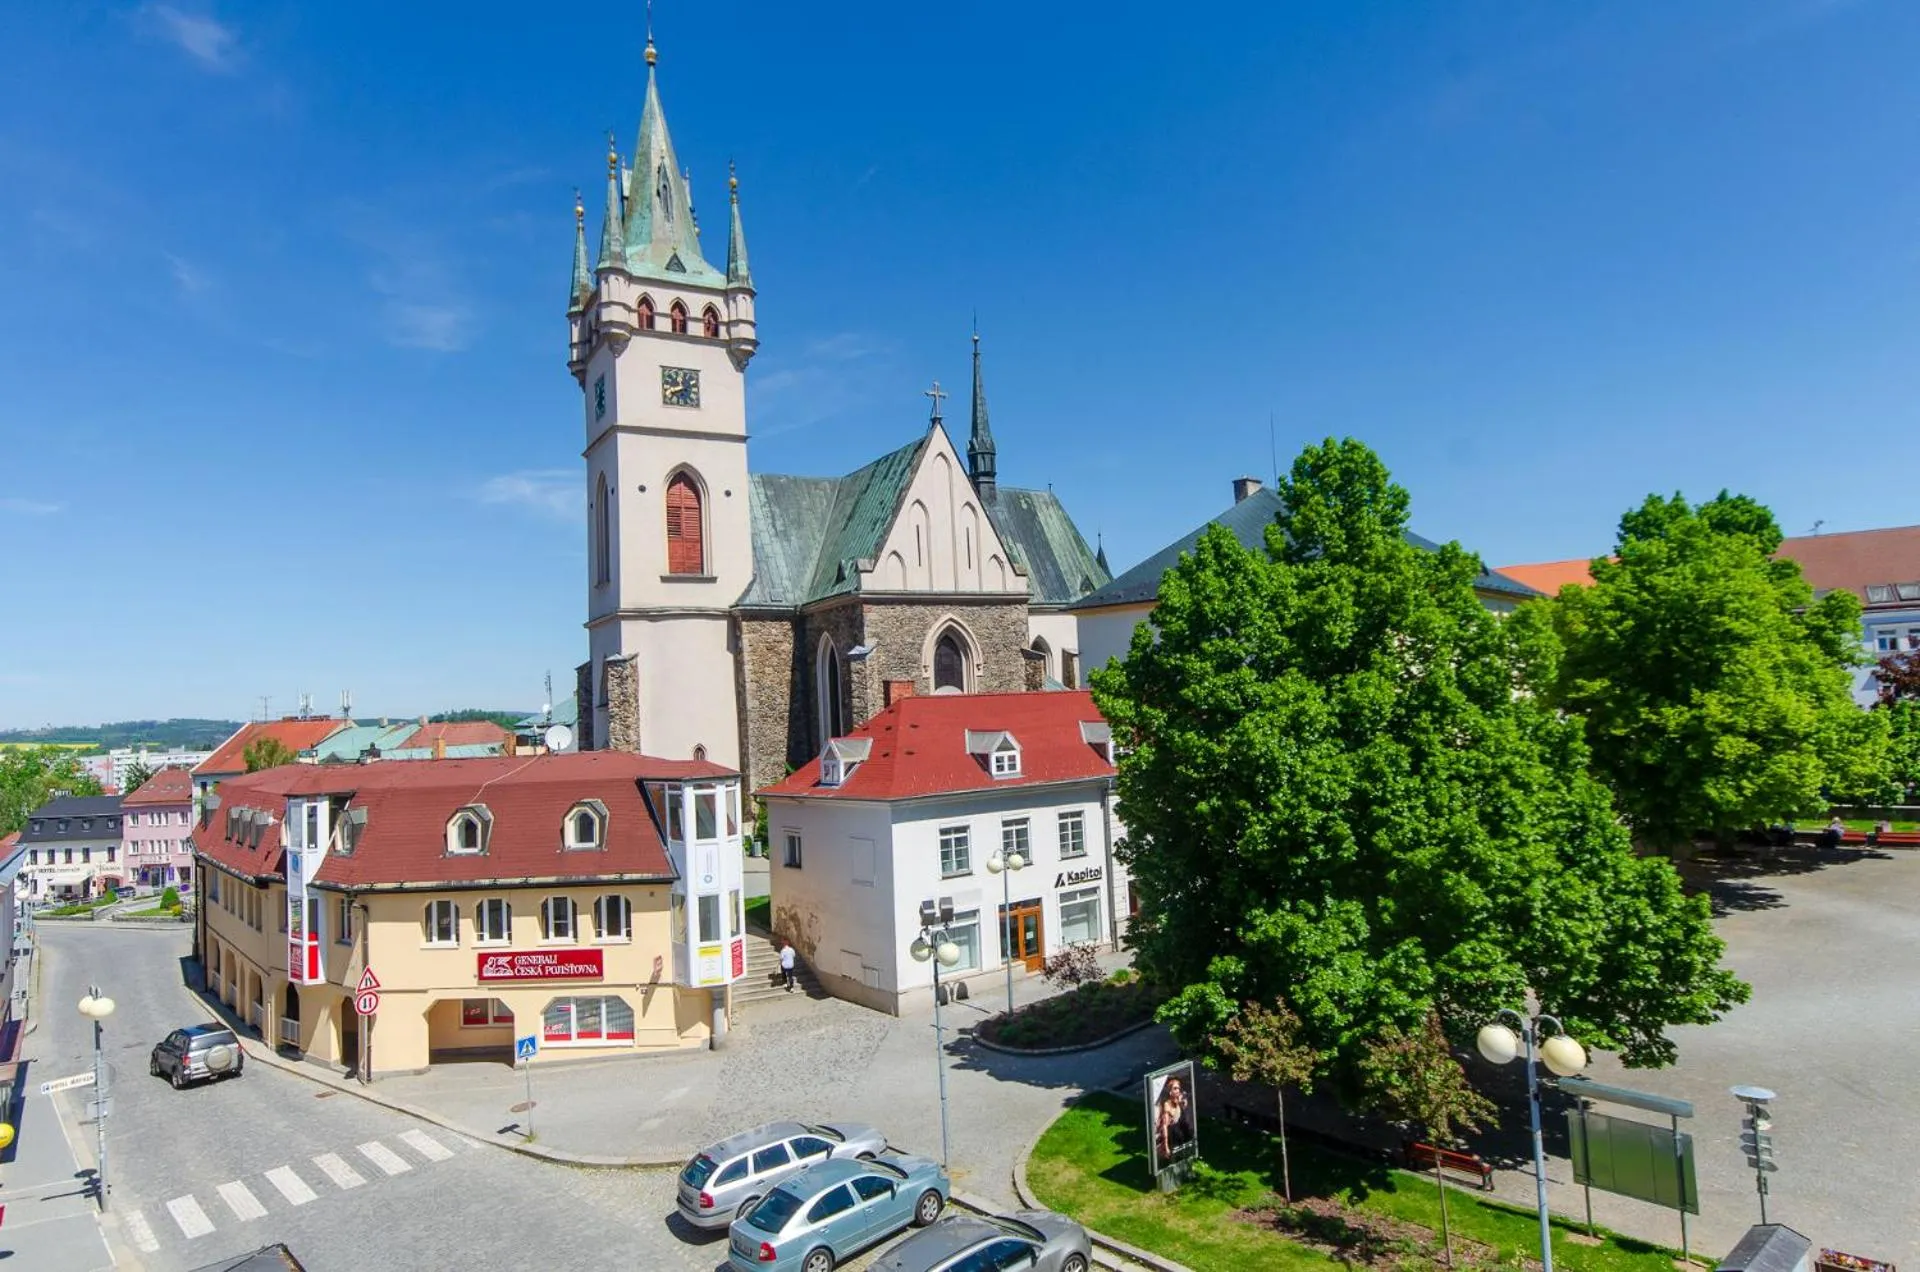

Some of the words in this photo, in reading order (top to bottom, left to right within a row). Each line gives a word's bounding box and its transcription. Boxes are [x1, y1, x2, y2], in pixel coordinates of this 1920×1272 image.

[1067, 866, 1102, 881] Kapitol
[514, 954, 558, 965] GENERALI
[514, 964, 543, 976] ČESKÁ
[545, 963, 599, 975] POJIŠŤOVNA
